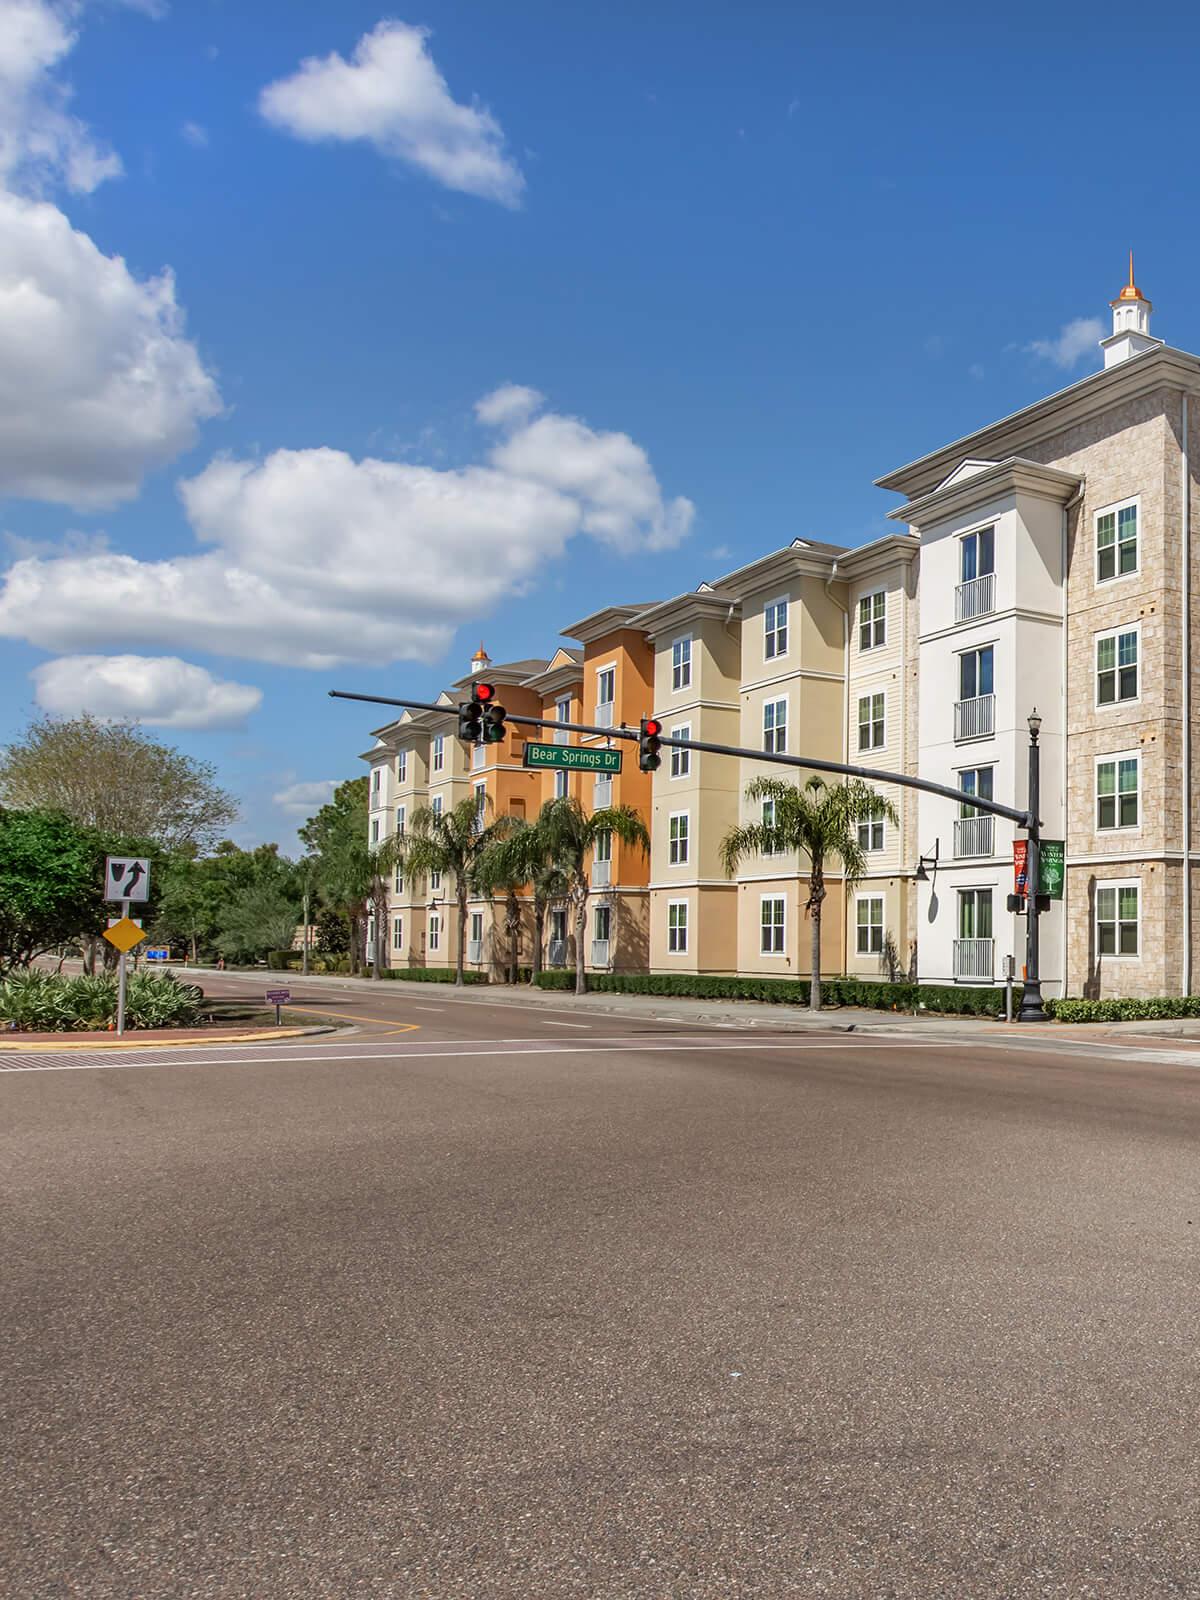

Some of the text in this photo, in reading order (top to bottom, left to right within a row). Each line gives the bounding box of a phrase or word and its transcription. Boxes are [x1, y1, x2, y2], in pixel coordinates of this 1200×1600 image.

[532, 747, 617, 767] Bear Springs Dr
